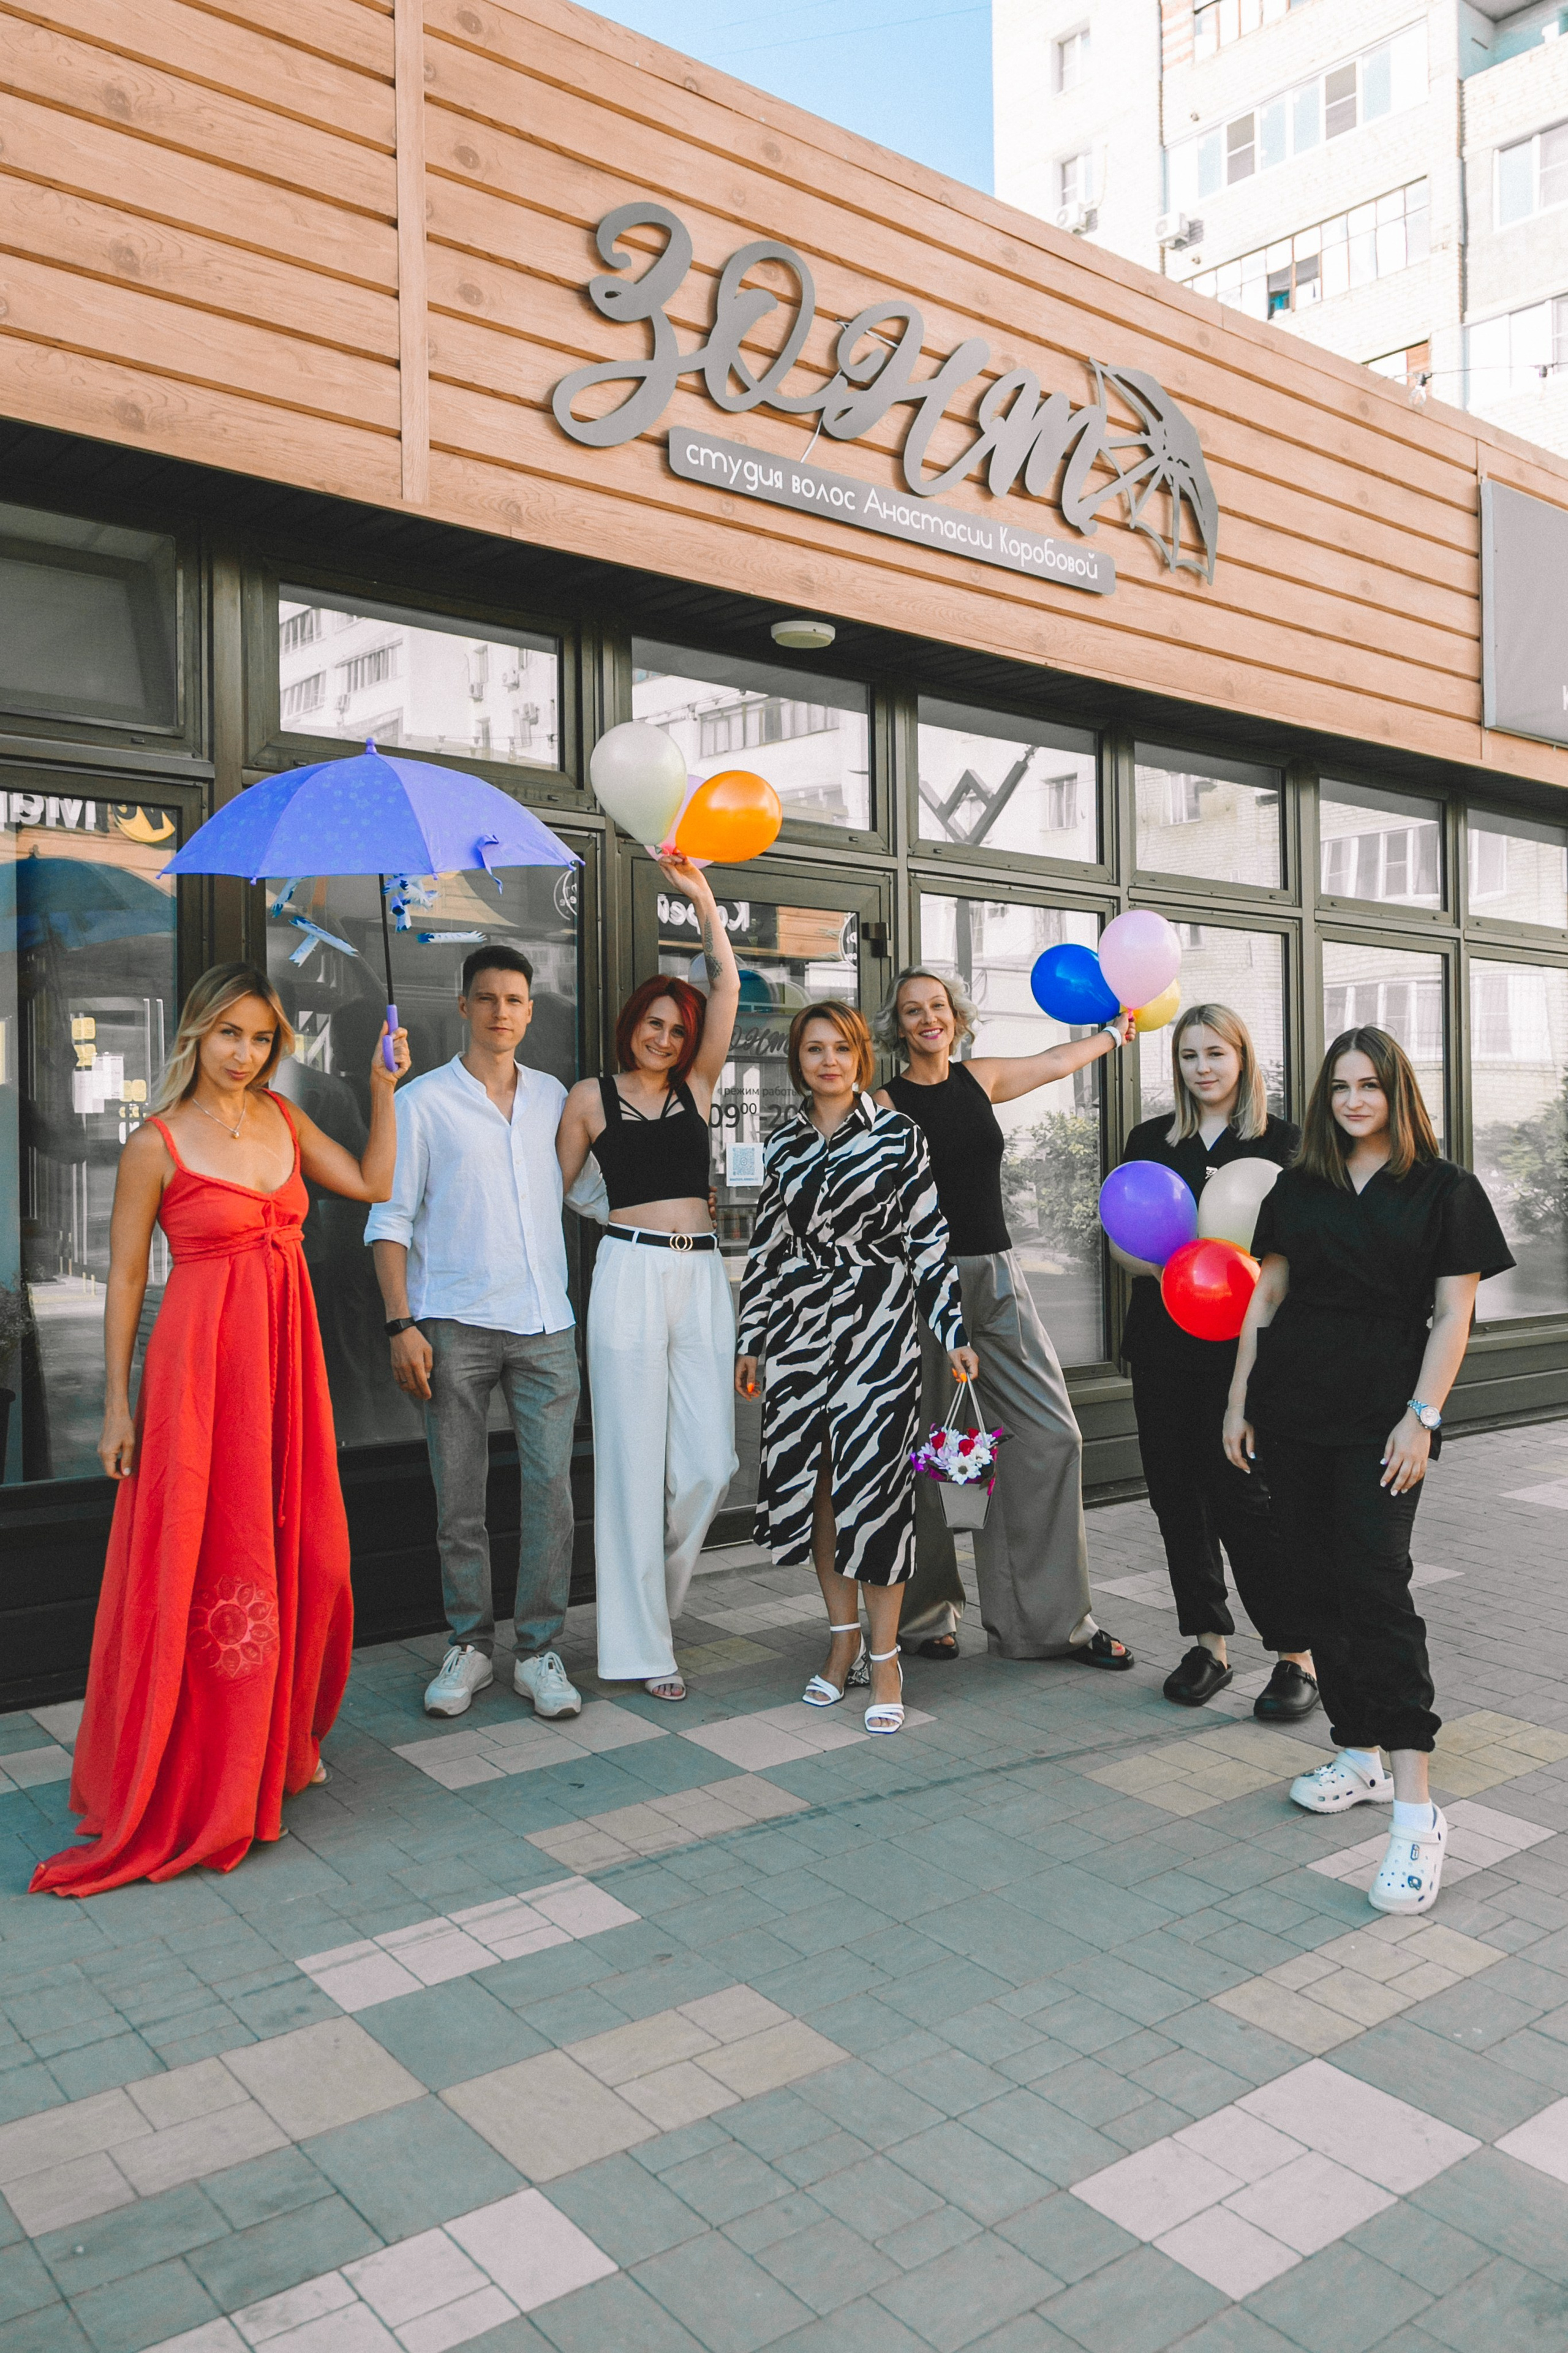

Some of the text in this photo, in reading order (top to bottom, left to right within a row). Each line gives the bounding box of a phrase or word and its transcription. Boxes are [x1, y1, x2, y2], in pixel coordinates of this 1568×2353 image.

[685, 444, 1099, 581] студия волос Анастасии Коробовой
[724, 1087, 759, 1098] режим
